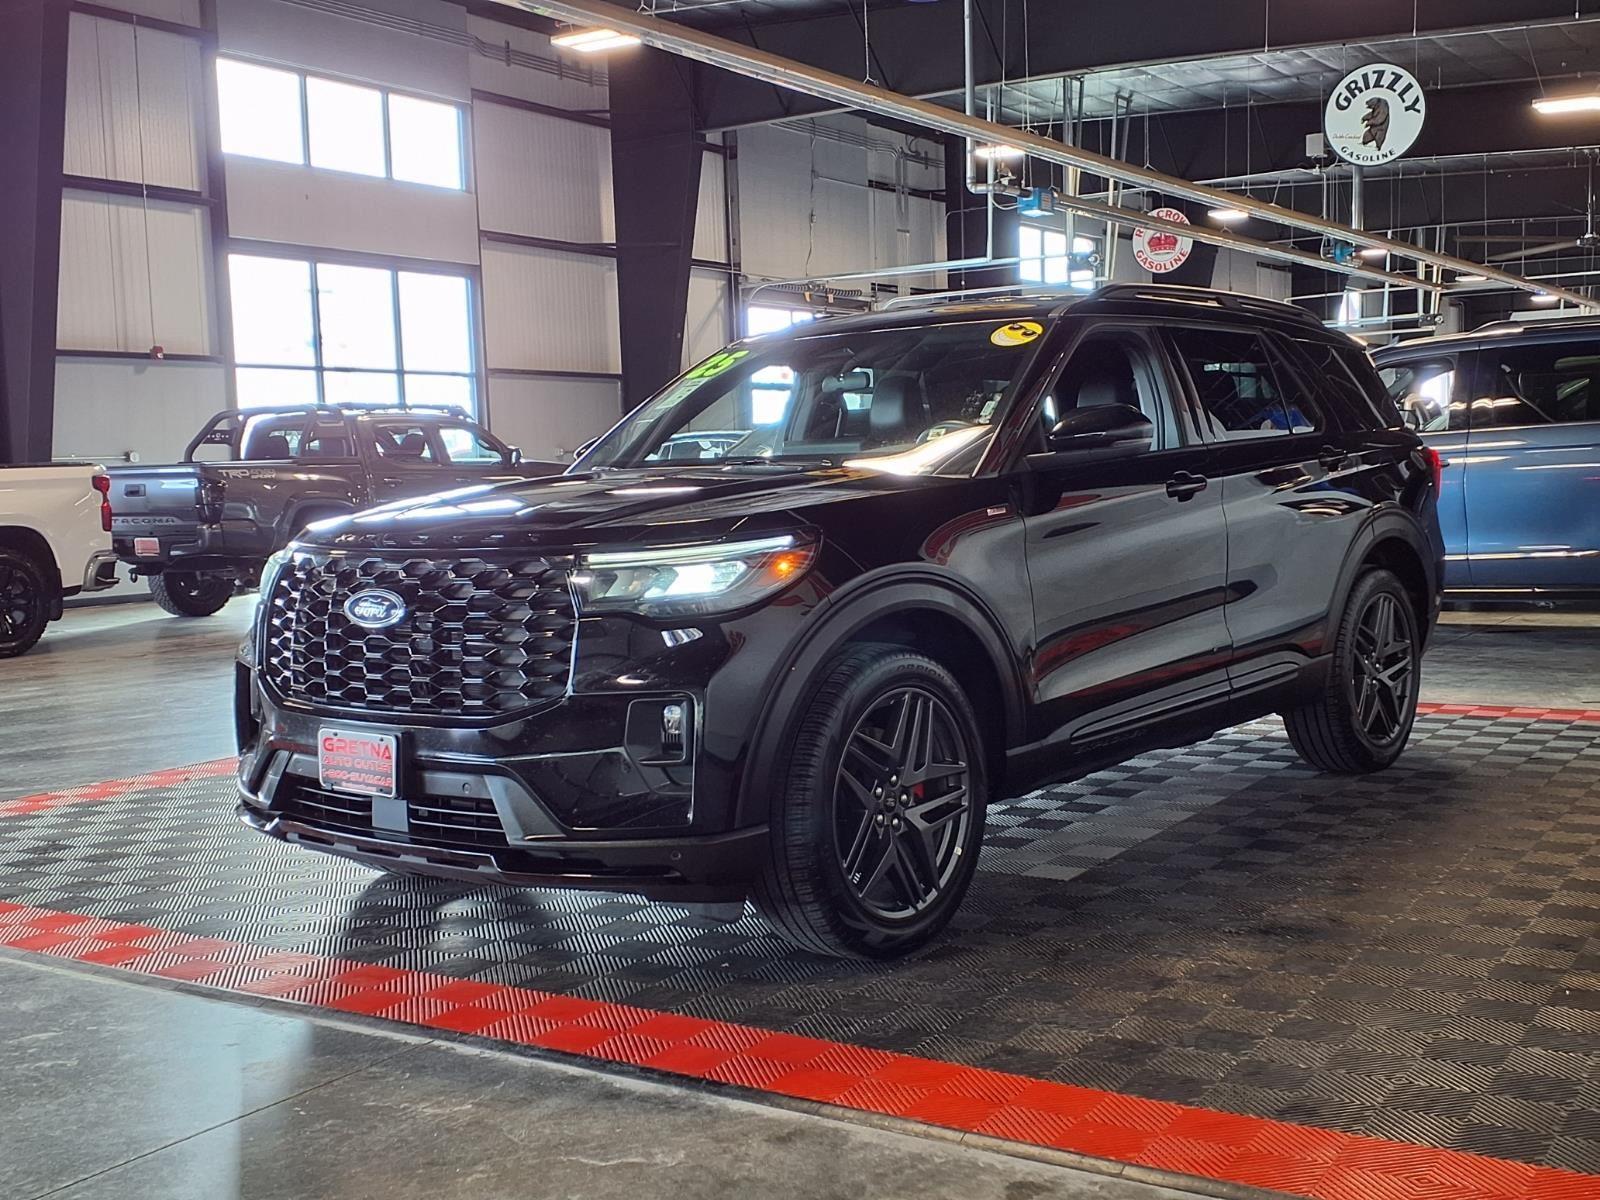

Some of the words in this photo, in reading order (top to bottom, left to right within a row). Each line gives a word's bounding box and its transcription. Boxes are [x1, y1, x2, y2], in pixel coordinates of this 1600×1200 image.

[1335, 69, 1421, 114] GRIZZLY
[1340, 145, 1396, 162] GASOLINE
[1156, 208, 1188, 223] CRO
[1136, 247, 1188, 271] GASOLINE
[111, 517, 175, 526] TACOMA
[322, 737, 392, 760] GRETNA
[322, 754, 353, 768] AUTO
